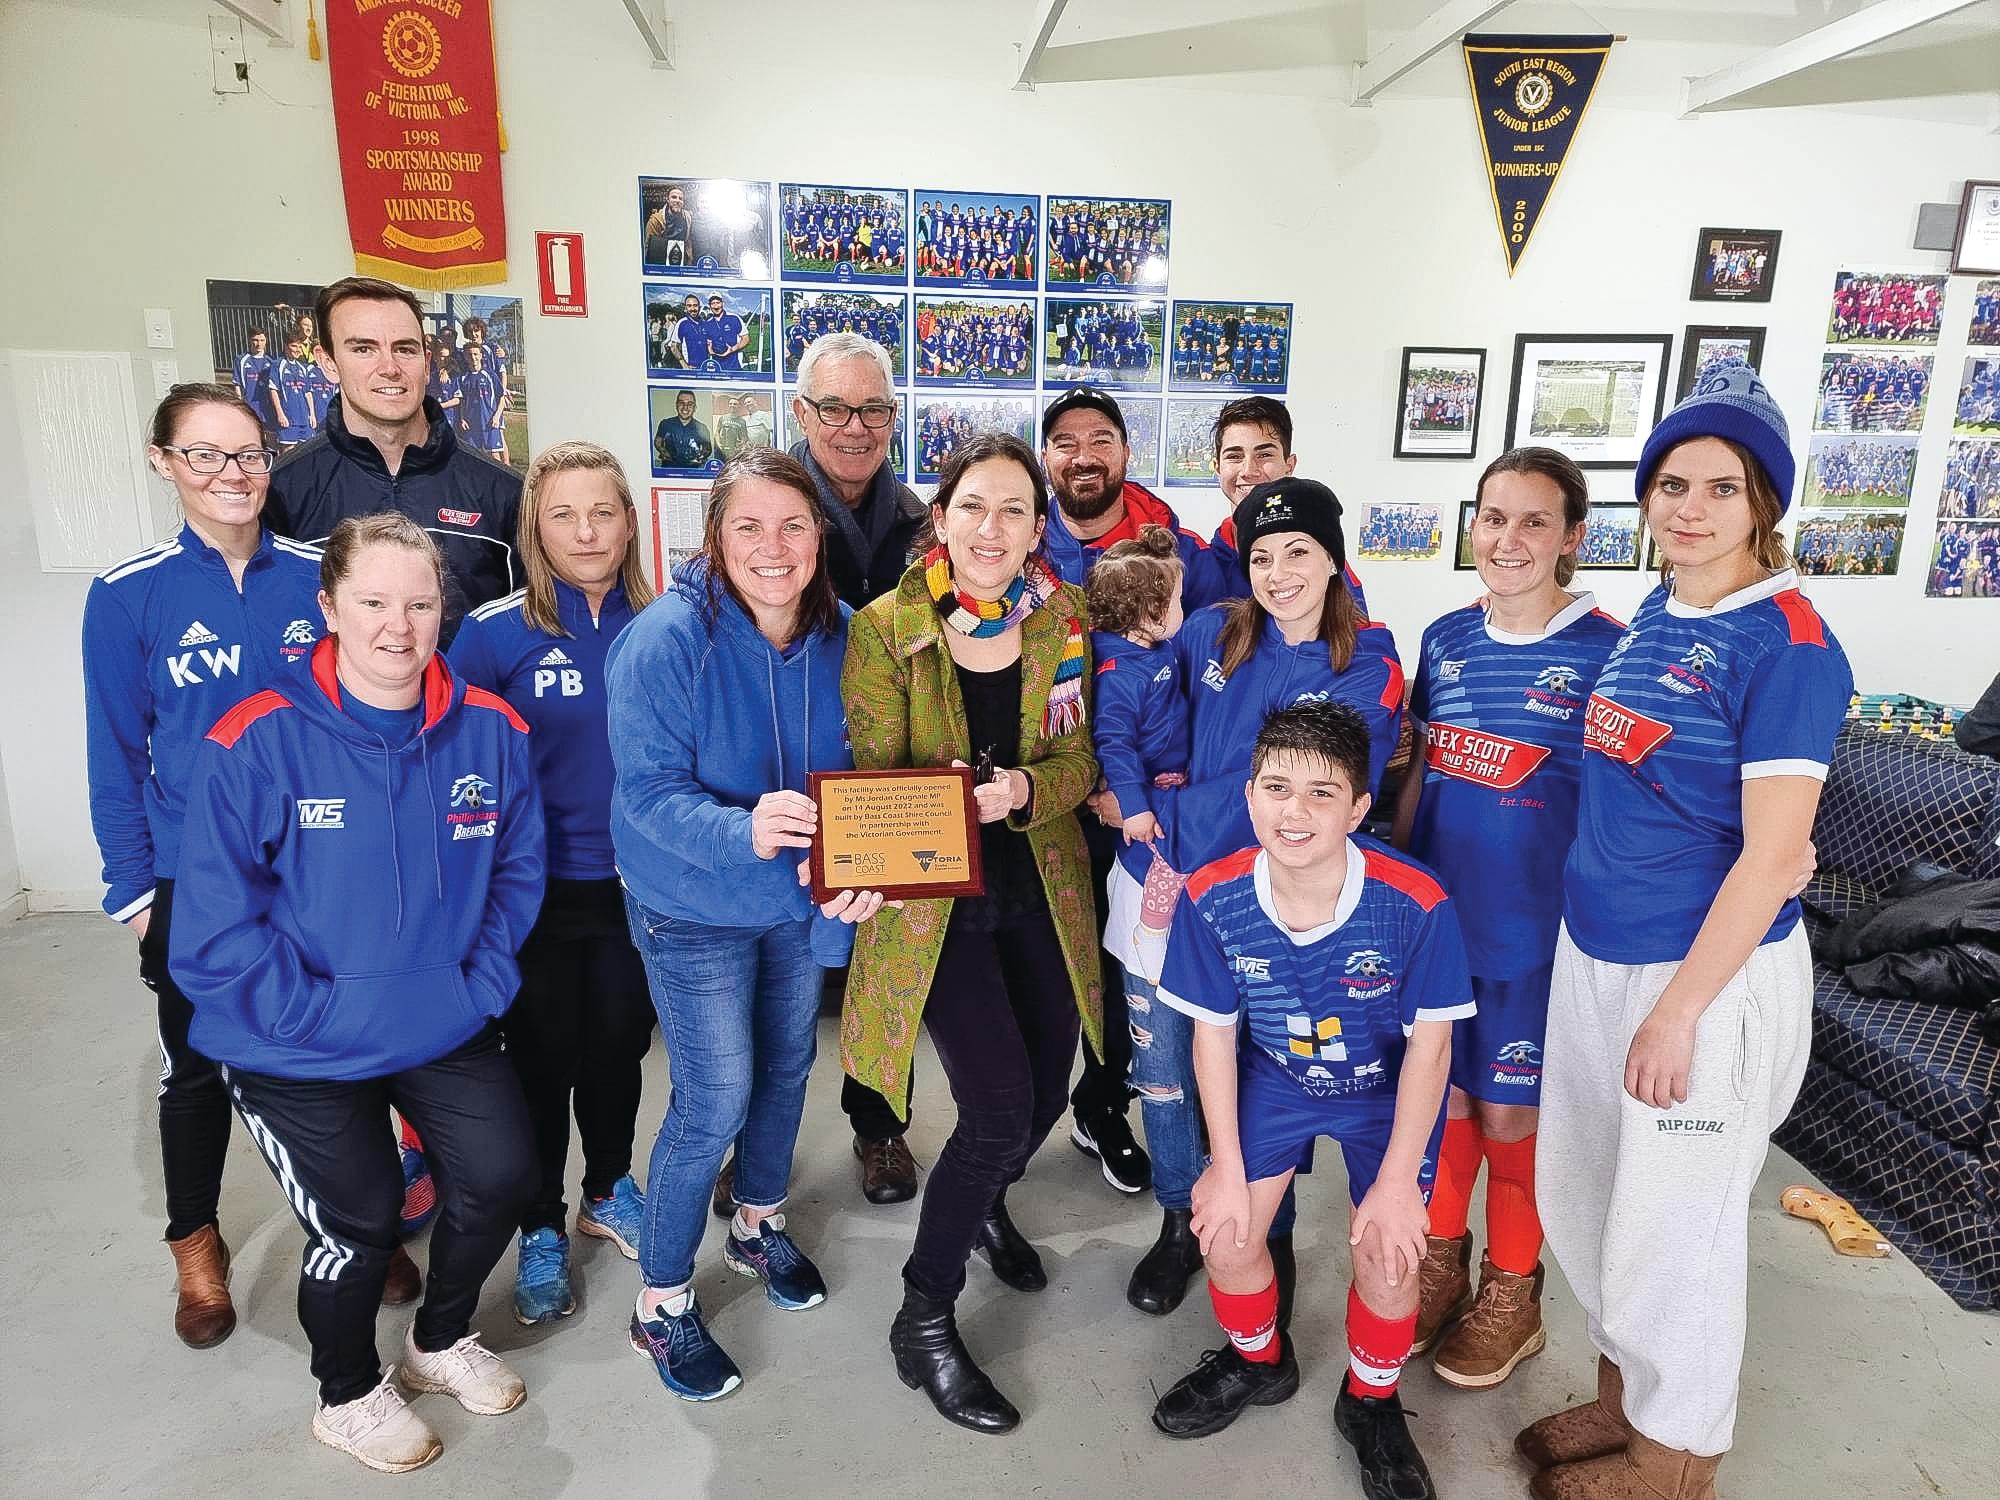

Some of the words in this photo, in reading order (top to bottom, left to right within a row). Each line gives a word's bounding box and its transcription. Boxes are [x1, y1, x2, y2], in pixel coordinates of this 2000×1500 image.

[1494, 62, 1521, 87] SOUTH
[1523, 58, 1544, 70] EAST
[1547, 60, 1577, 86] REGION
[382, 80, 453, 101] FEDERATION
[365, 91, 382, 109] OF
[447, 97, 472, 116] INC.
[1493, 108, 1528, 132] JUNIOR
[1532, 105, 1572, 132] LEAGUE
[401, 129, 440, 145] 1998
[366, 149, 482, 172] SPORTSMANSHIP
[1494, 163, 1559, 177] RUNNERS-UP
[402, 172, 452, 192] AWARD
[384, 198, 475, 223] WINNERS
[1511, 200, 1527, 243] 2000
[179, 634, 219, 647] adidas
[534, 669, 584, 698] PB
[1524, 698, 1573, 720] BREAKERS
[1461, 736, 1514, 766] SCOTT
[1441, 752, 1463, 767] AND
[1464, 758, 1504, 780] STAFF
[850, 786, 873, 795] facility
[891, 784, 922, 793] officially
[845, 796, 854, 804] by
[867, 794, 894, 802] Jordan
[894, 793, 928, 802] Crugnale
[865, 804, 892, 812] August
[925, 810, 953, 818] Council
[452, 820, 496, 841] BREAKERS
[868, 821, 911, 830] partnership
[860, 831, 894, 839] Victorian
[895, 829, 944, 837] Government.
[854, 852, 886, 866] BASS
[918, 856, 962, 865] VICTORIA
[855, 864, 885, 874] COAST
[1348, 984, 1392, 1000] BREAKERS
[1302, 1077, 1387, 1097] AVATION
[1493, 1072, 1537, 1086] BREAKERS
[1656, 1119, 1725, 1133] RIPCURL
